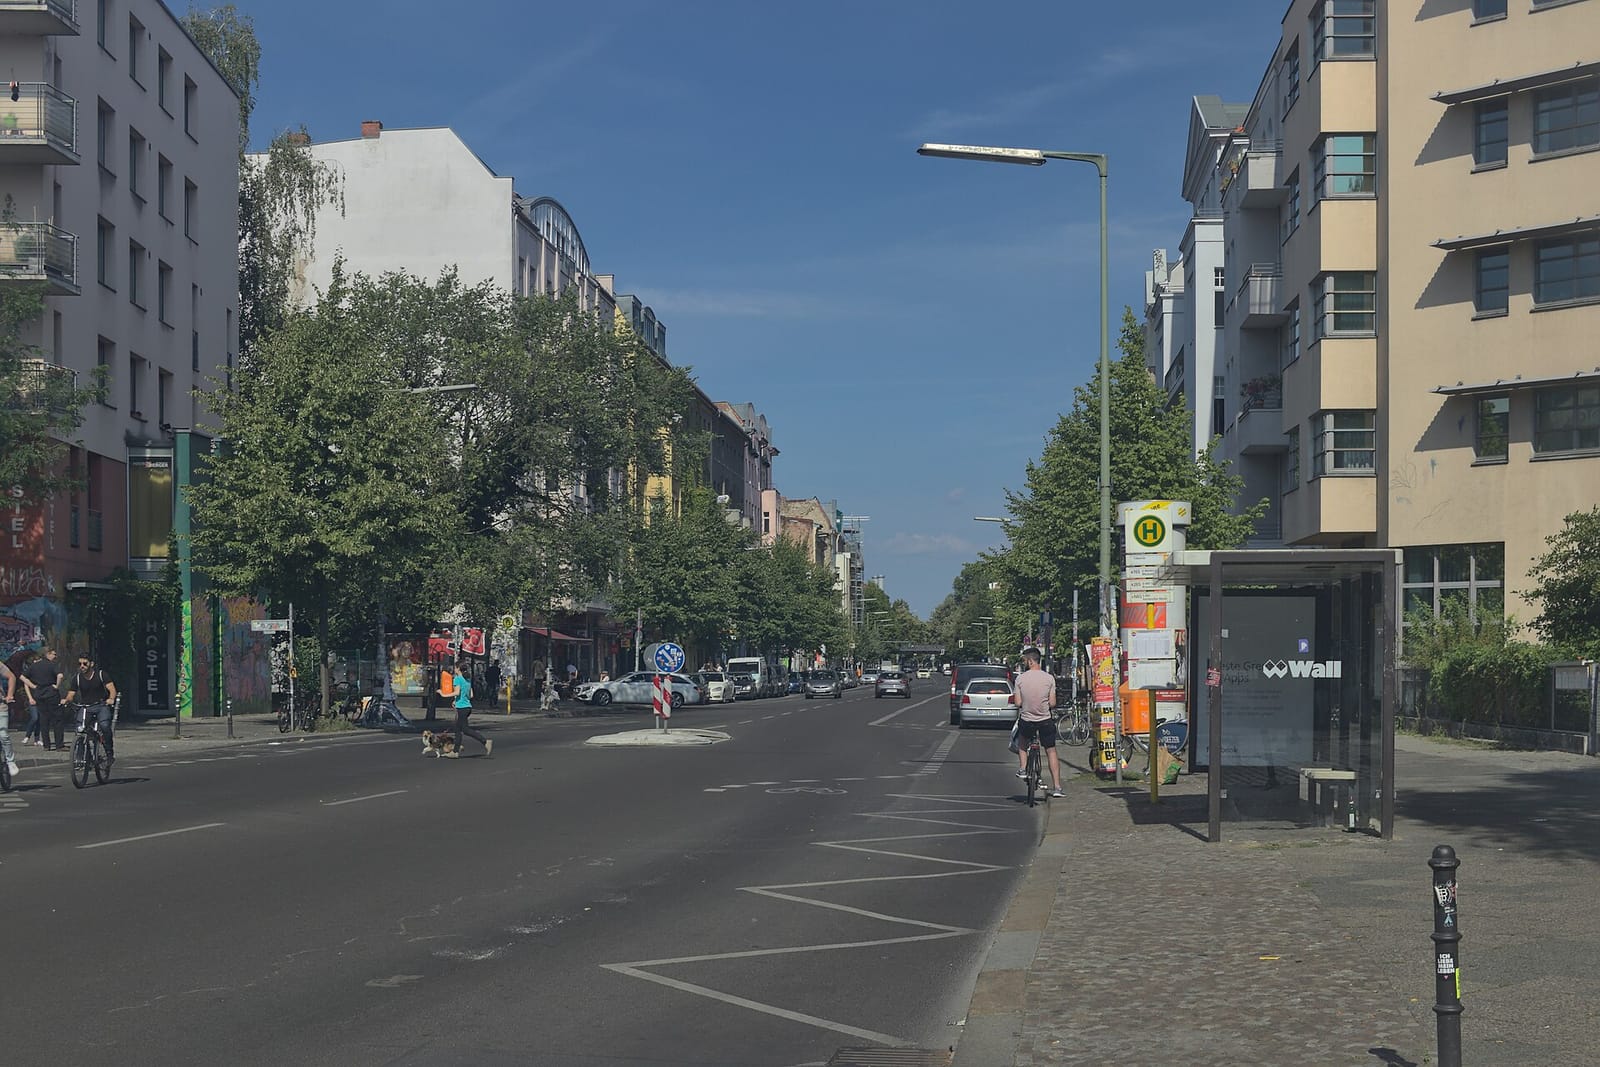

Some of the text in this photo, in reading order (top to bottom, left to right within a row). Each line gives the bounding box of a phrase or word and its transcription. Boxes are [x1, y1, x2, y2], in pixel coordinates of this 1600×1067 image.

[11, 484, 24, 549] STEL
[1142, 523, 1157, 540] H
[146, 620, 158, 706] HOSTEL
[1288, 660, 1341, 678] Wall
